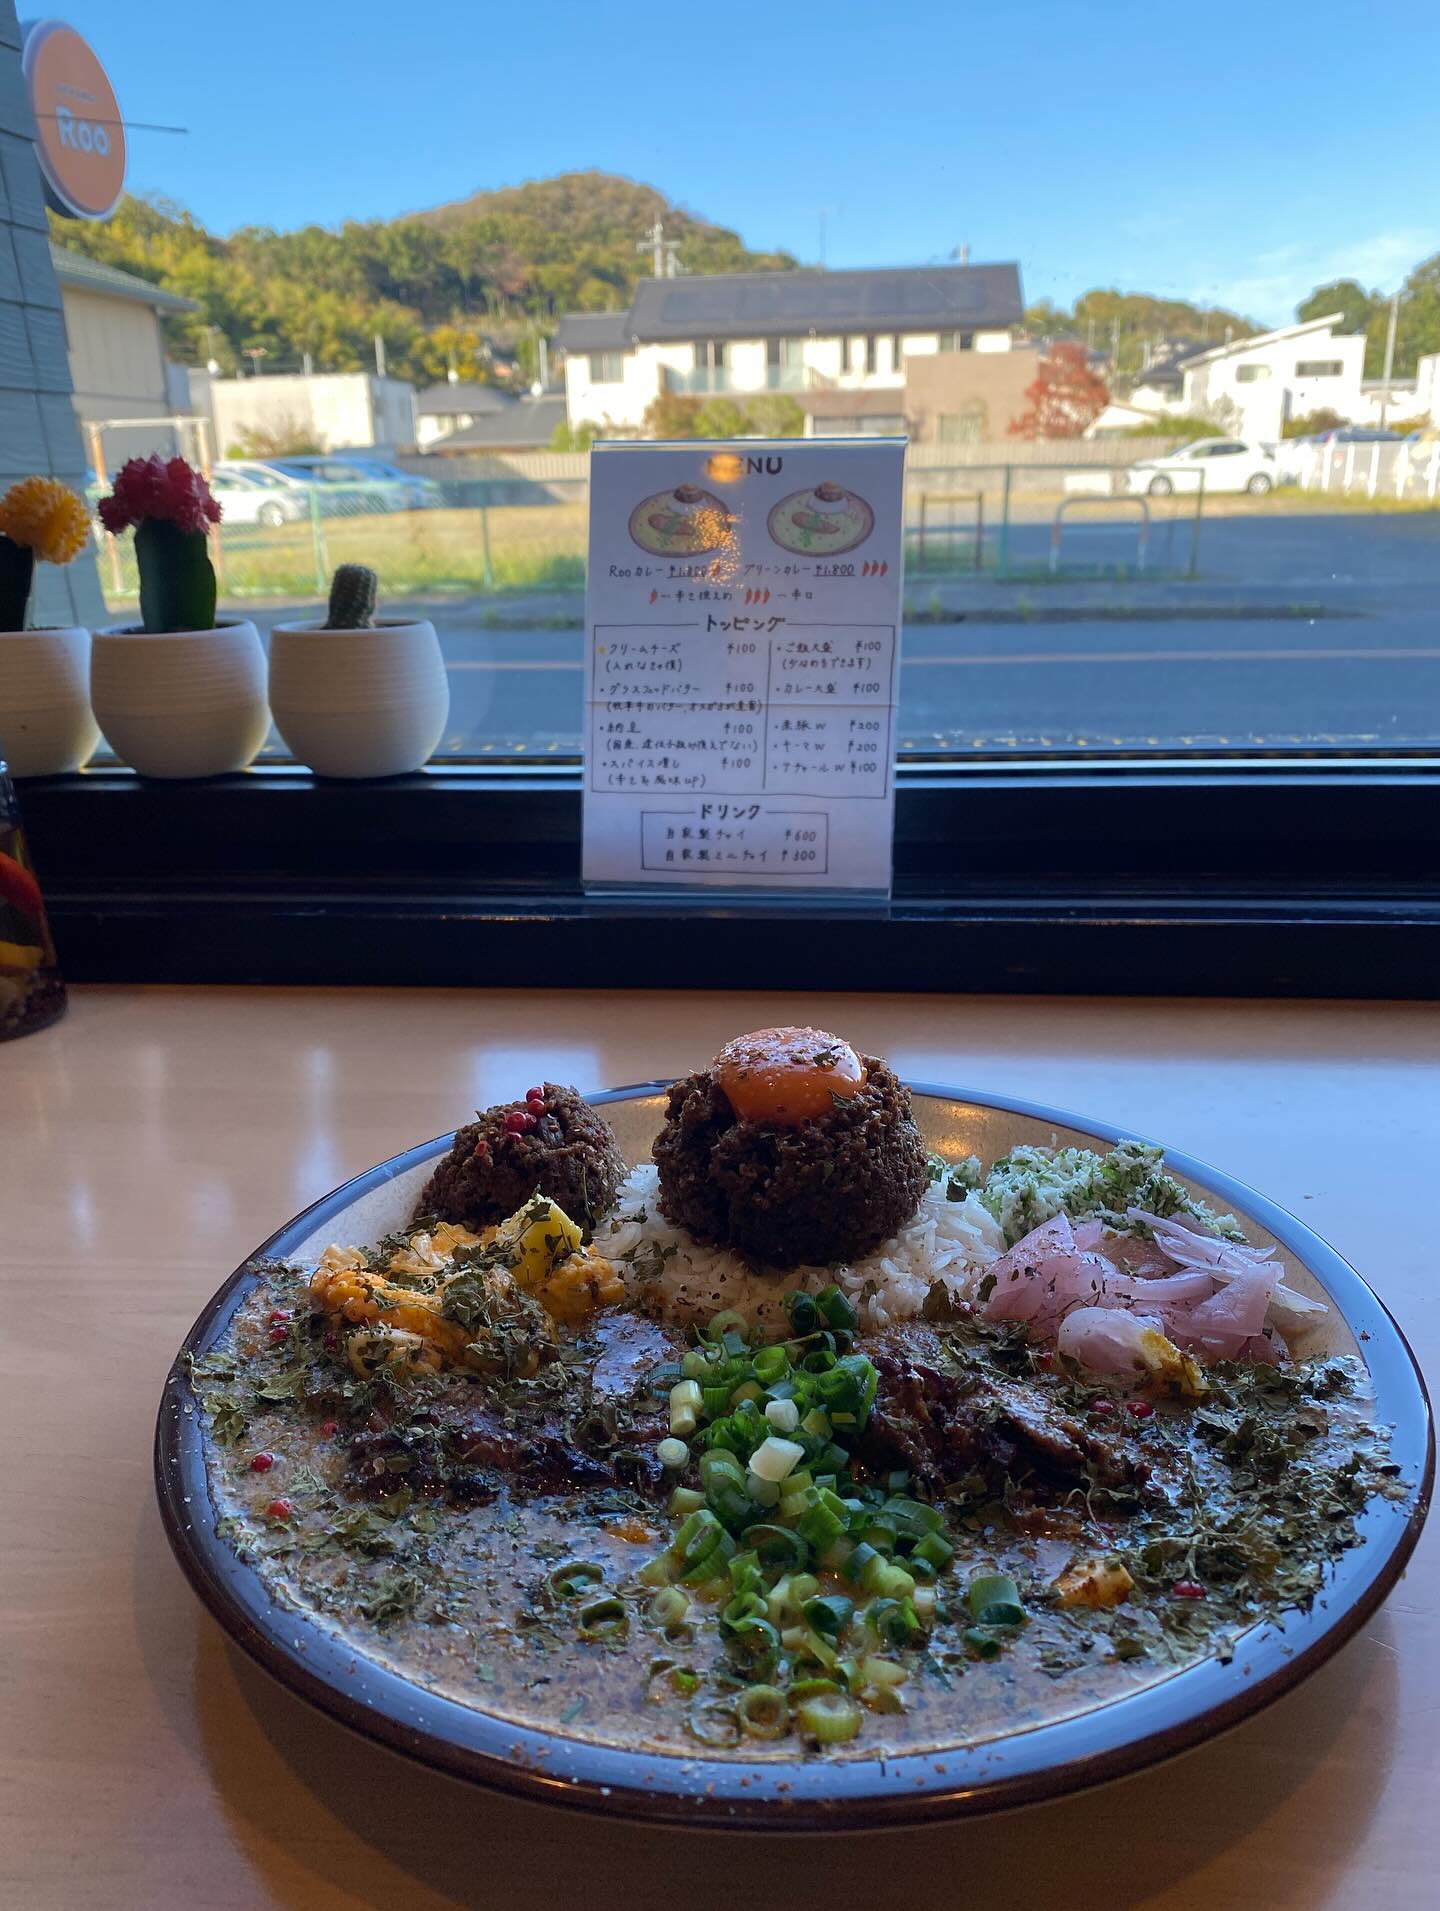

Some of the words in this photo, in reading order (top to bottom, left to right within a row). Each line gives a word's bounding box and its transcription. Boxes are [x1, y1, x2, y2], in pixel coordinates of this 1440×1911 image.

[56, 106, 109, 156] Roo
[707, 456, 782, 475] NU
[707, 614, 786, 632] トッピング
[609, 642, 681, 655] クリームチーズ
[727, 642, 756, 655] ¥100
[855, 641, 881, 653] ¥100
[725, 682, 754, 695] ¥100
[853, 682, 880, 694] ¥100
[723, 722, 753, 734] ¥100
[850, 719, 880, 732] ¥200
[848, 740, 877, 753] ¥200
[721, 757, 751, 769] ¥100
[850, 760, 877, 774] ¥100
[701, 804, 760, 820] ドリンク
[784, 829, 816, 842] ¥600
